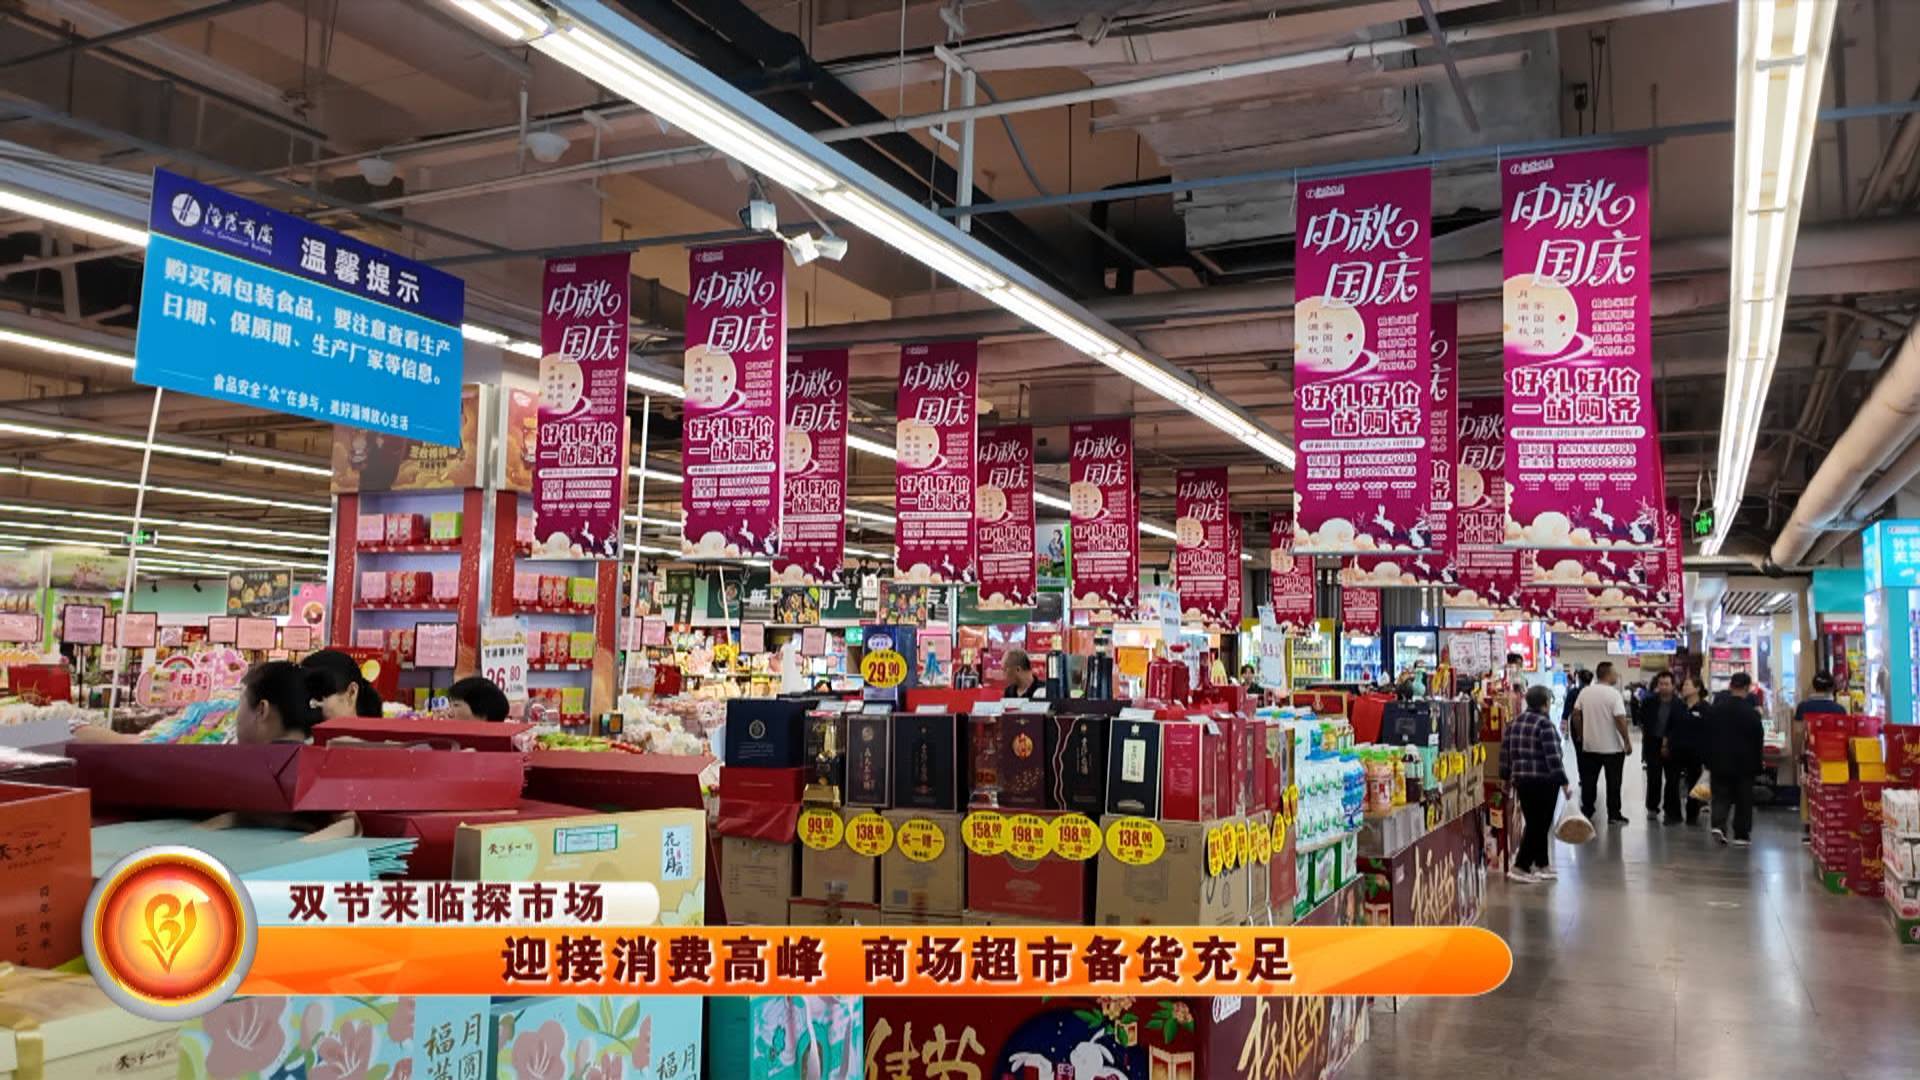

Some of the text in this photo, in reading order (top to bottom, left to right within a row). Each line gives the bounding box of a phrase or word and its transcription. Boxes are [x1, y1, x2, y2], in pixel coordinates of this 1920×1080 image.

[1510, 178, 1636, 232] 中秋
[1303, 204, 1420, 254] 中秋
[300, 236, 420, 304] 温馨提示
[1533, 230, 1642, 288] 国庆
[693, 268, 776, 310] 中秋
[1322, 251, 1423, 308] 国庆
[548, 280, 622, 320] 中秋
[560, 319, 624, 361] 国庆
[707, 308, 777, 353] 国庆
[786, 368, 843, 399] 中秋
[904, 360, 970, 392] 中秋
[1512, 367, 1640, 396] 好礼好价
[914, 391, 972, 427] 国庆
[1302, 381, 1421, 411] 好礼好价
[1512, 396, 1641, 424] 一站购齐
[689, 415, 774, 442] 好礼好价
[789, 398, 844, 432] 国庆
[1302, 408, 1421, 436] 一站购齐
[541, 423, 616, 446] 好礼好价
[1074, 434, 1127, 460] 中秋
[541, 444, 616, 467] 一站购齐
[688, 440, 773, 462] 一站购齐
[979, 440, 1029, 465] 中秋
[900, 475, 970, 494] 好礼好价
[989, 464, 1030, 490] 国庆
[1083, 459, 1128, 487] 国庆
[900, 492, 970, 511] 一站购齐
[1179, 479, 1225, 500] 中秋
[1187, 500, 1225, 522] 国庆
[1118, 829, 1153, 846] 138.00
